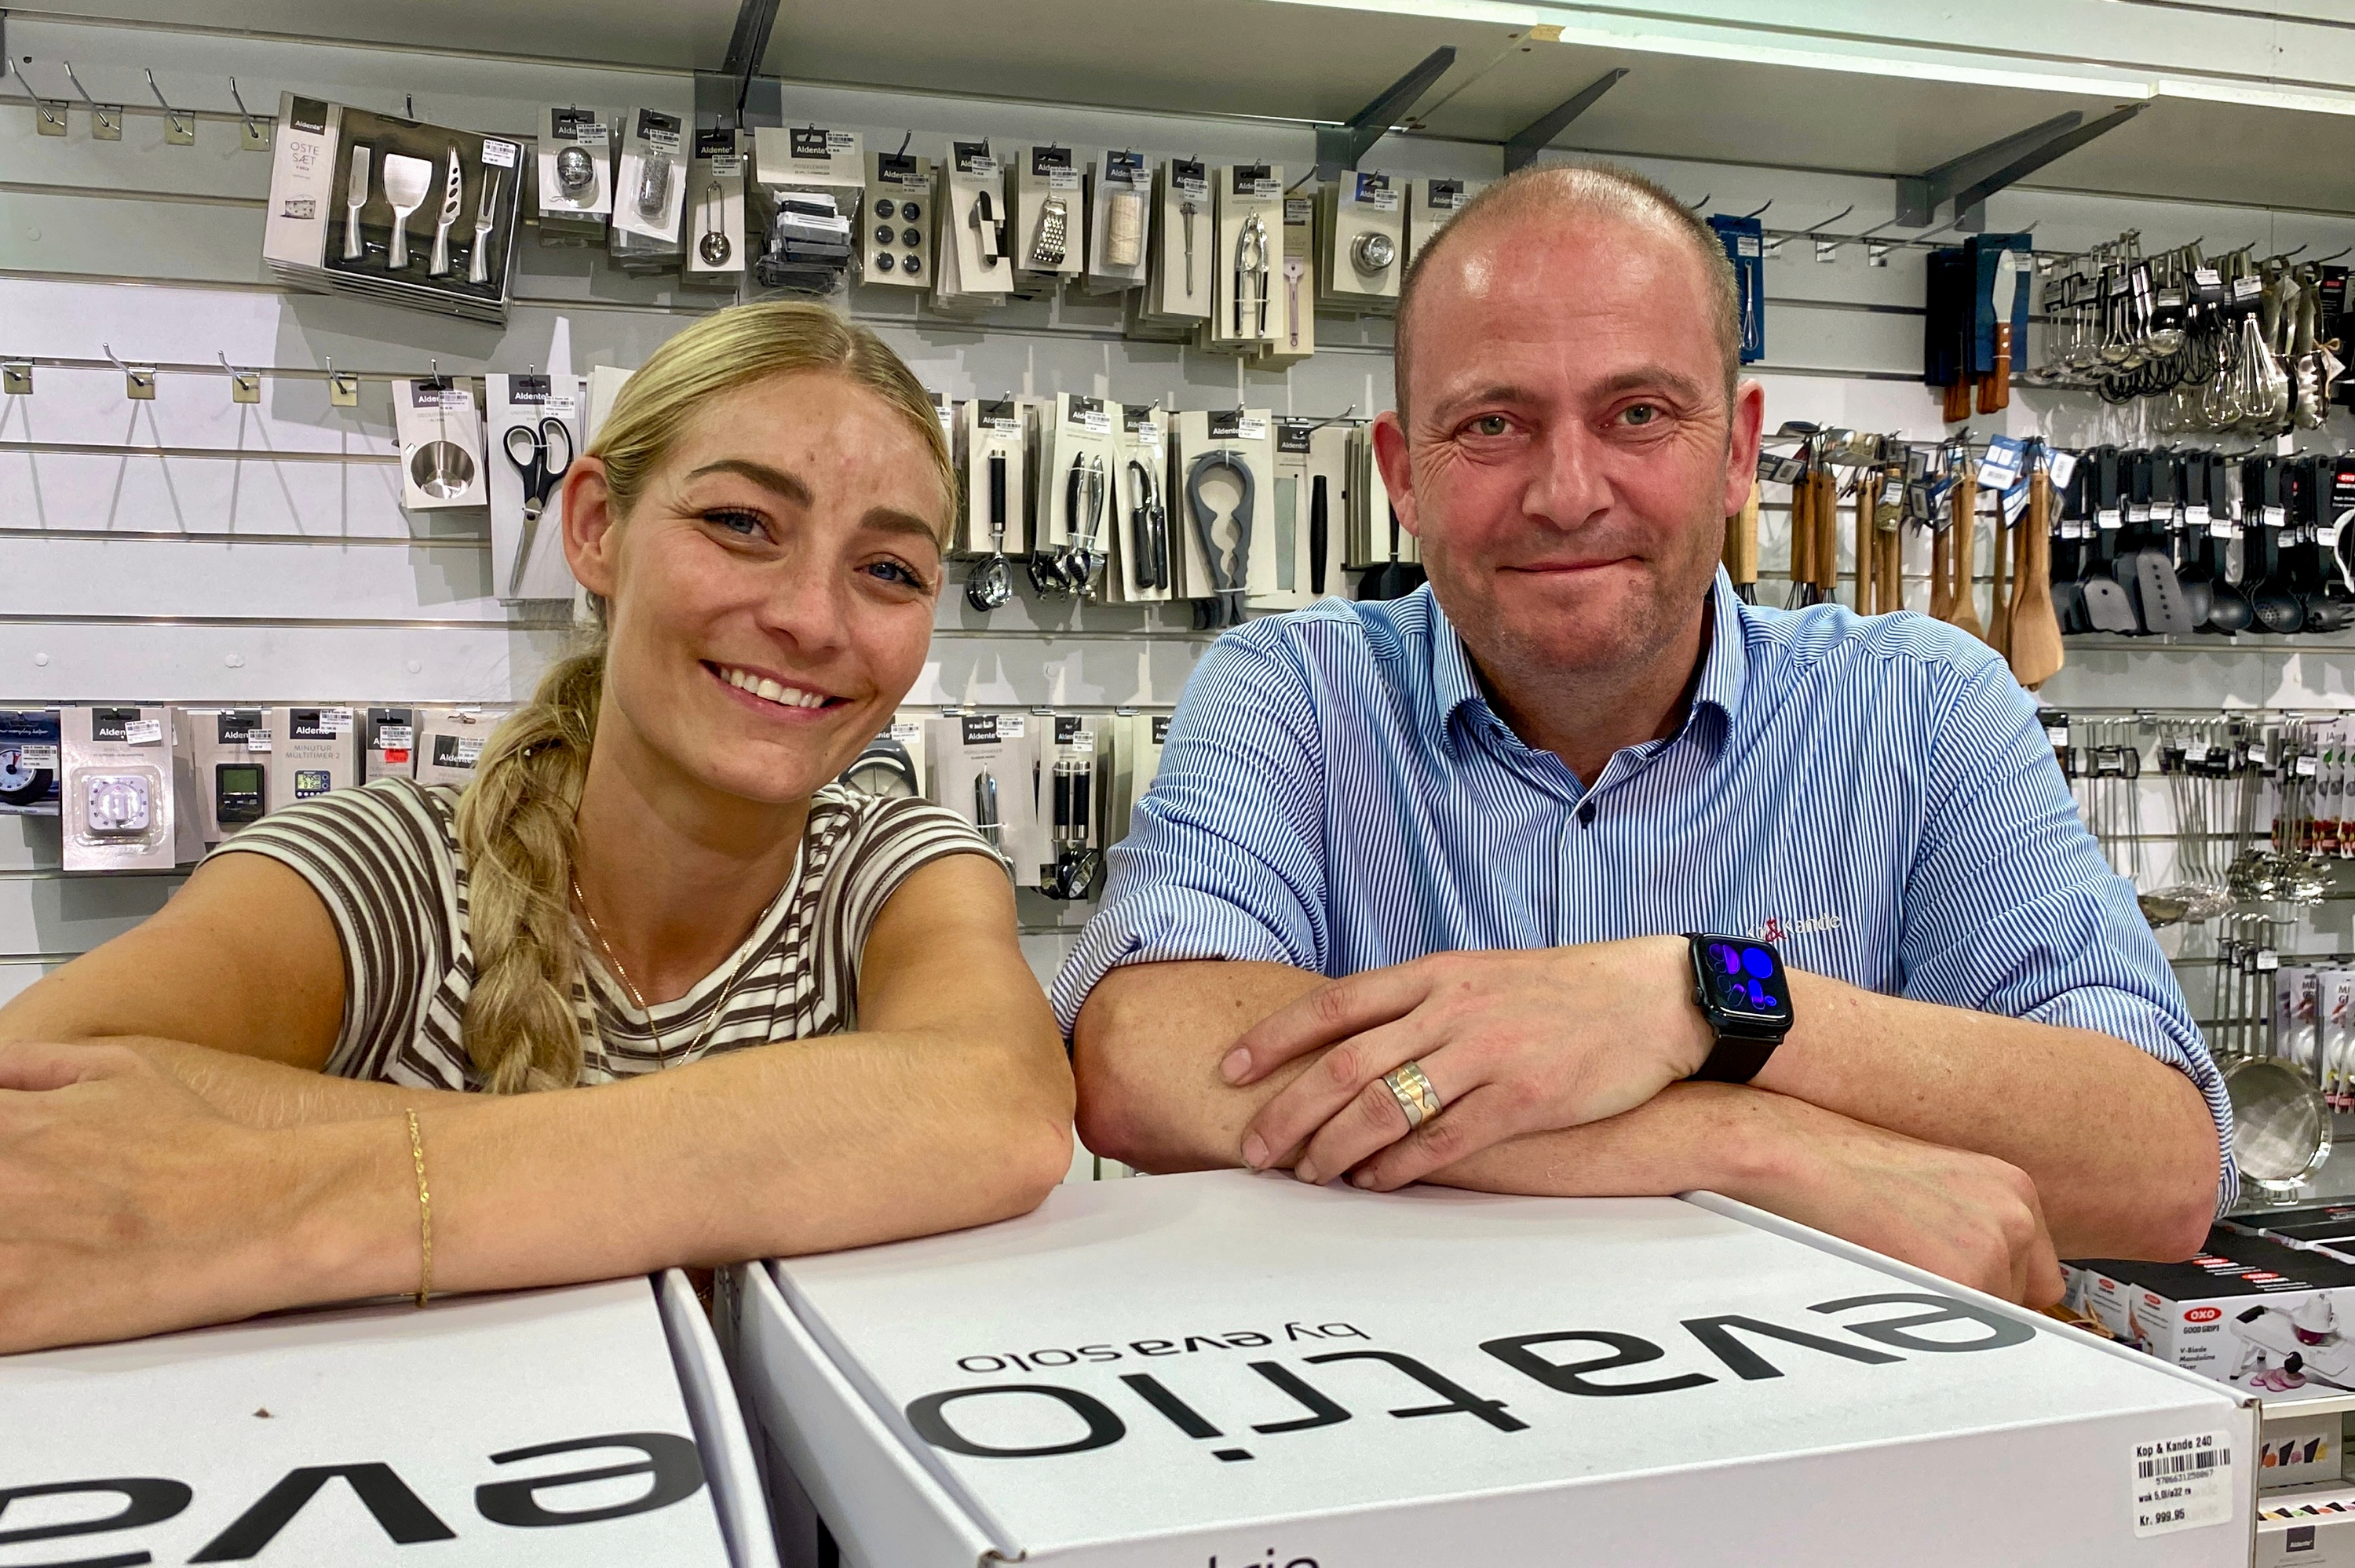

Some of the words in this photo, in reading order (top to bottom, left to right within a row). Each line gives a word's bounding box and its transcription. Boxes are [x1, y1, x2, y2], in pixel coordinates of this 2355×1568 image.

[290, 142, 320, 155] OSTE
[796, 145, 826, 155] Aldente
[292, 153, 316, 166] SÆT
[99, 727, 126, 736] Alden
[967, 731, 996, 741] Aldente
[1765, 918, 1787, 943] &
[1785, 913, 1841, 935] Kande
[2190, 1310, 2215, 1320] OXO
[1284, 1321, 1372, 1344] by
[2183, 1326, 2201, 1334] GOOD
[1478, 1293, 2038, 1396] eva
[904, 1350, 1532, 1462] trio
[2137, 1446, 2153, 1458] Kop
[2156, 1442, 2163, 1454] &
[2167, 1439, 2193, 1453] Kande
[2196, 1435, 2212, 1448] 240
[2138, 1493, 2152, 1503] wok
[2139, 1515, 2153, 1526] Kr.
[2156, 1508, 2185, 1523] 999.95
